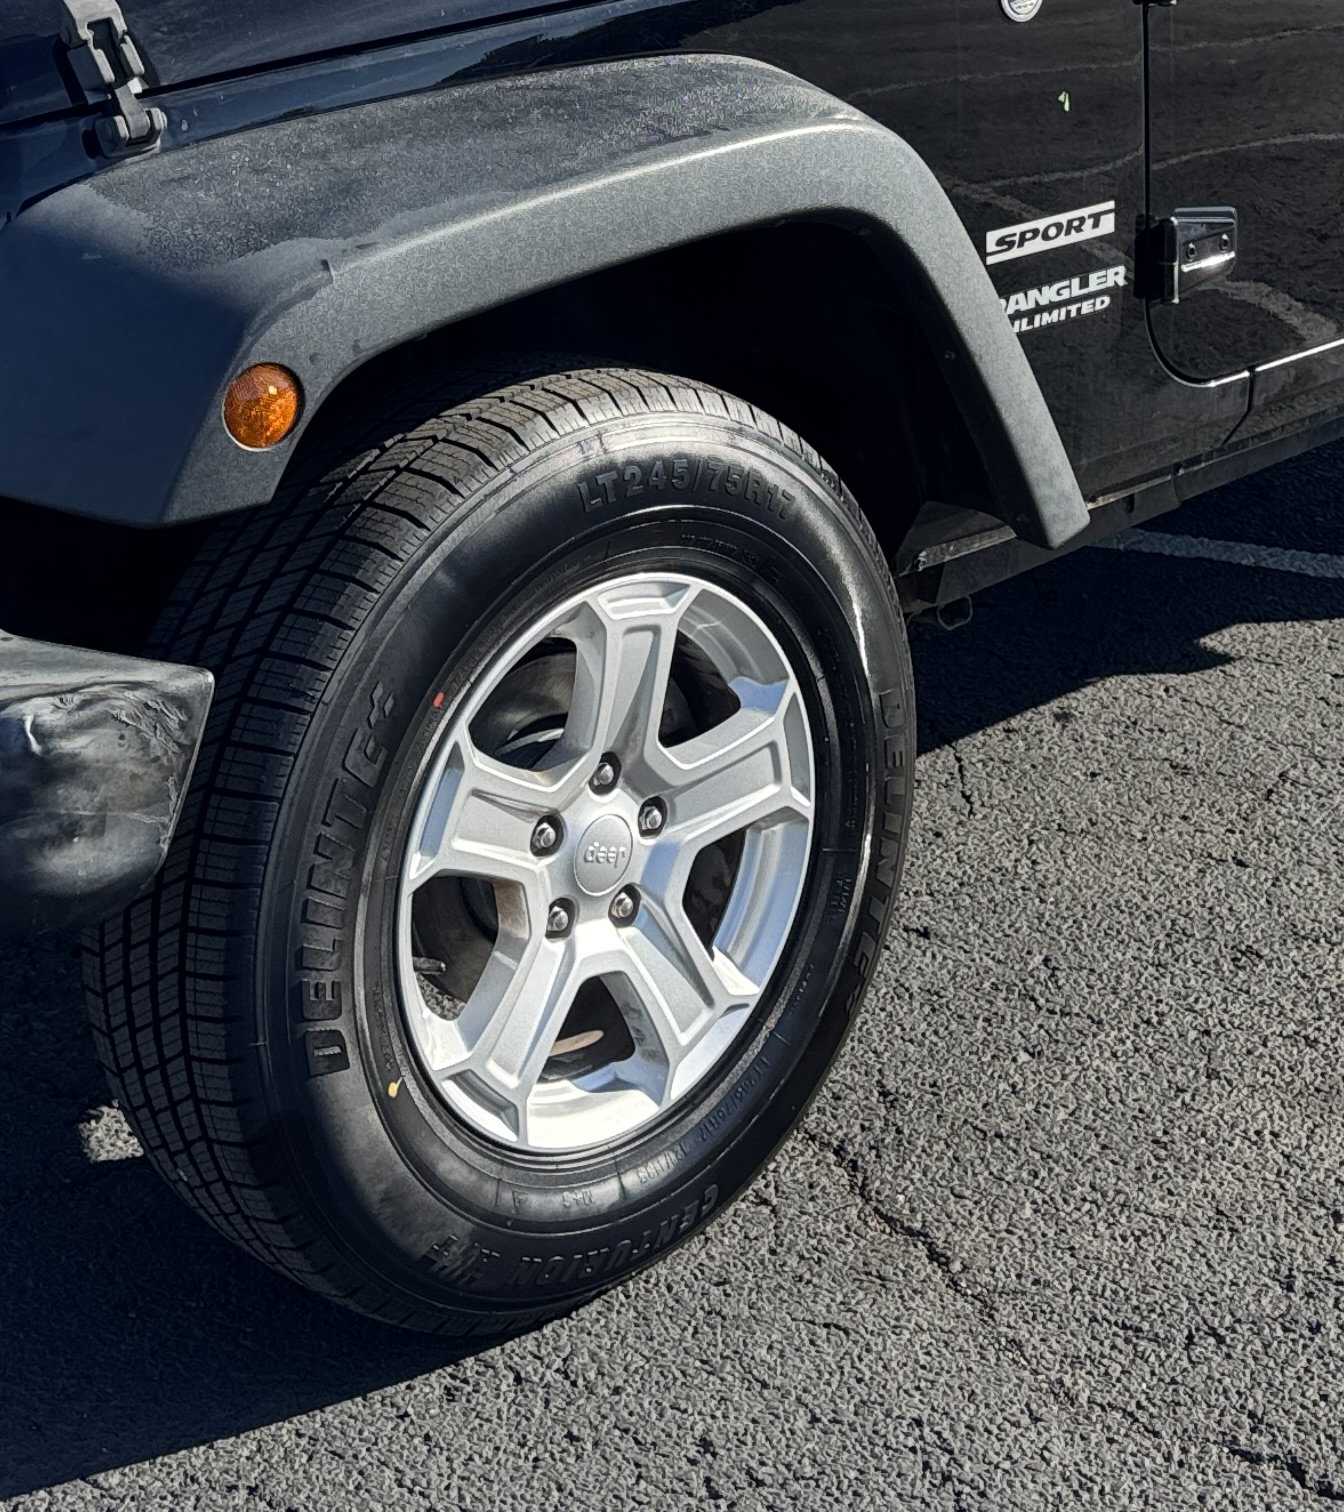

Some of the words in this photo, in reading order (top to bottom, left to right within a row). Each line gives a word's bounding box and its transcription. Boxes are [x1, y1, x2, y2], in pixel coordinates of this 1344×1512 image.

[994, 211, 1108, 254] SPORT
[577, 458, 797, 520] LT245/75R17
[583, 840, 628, 870] Jeep
[301, 726, 390, 1078] DELINTE
